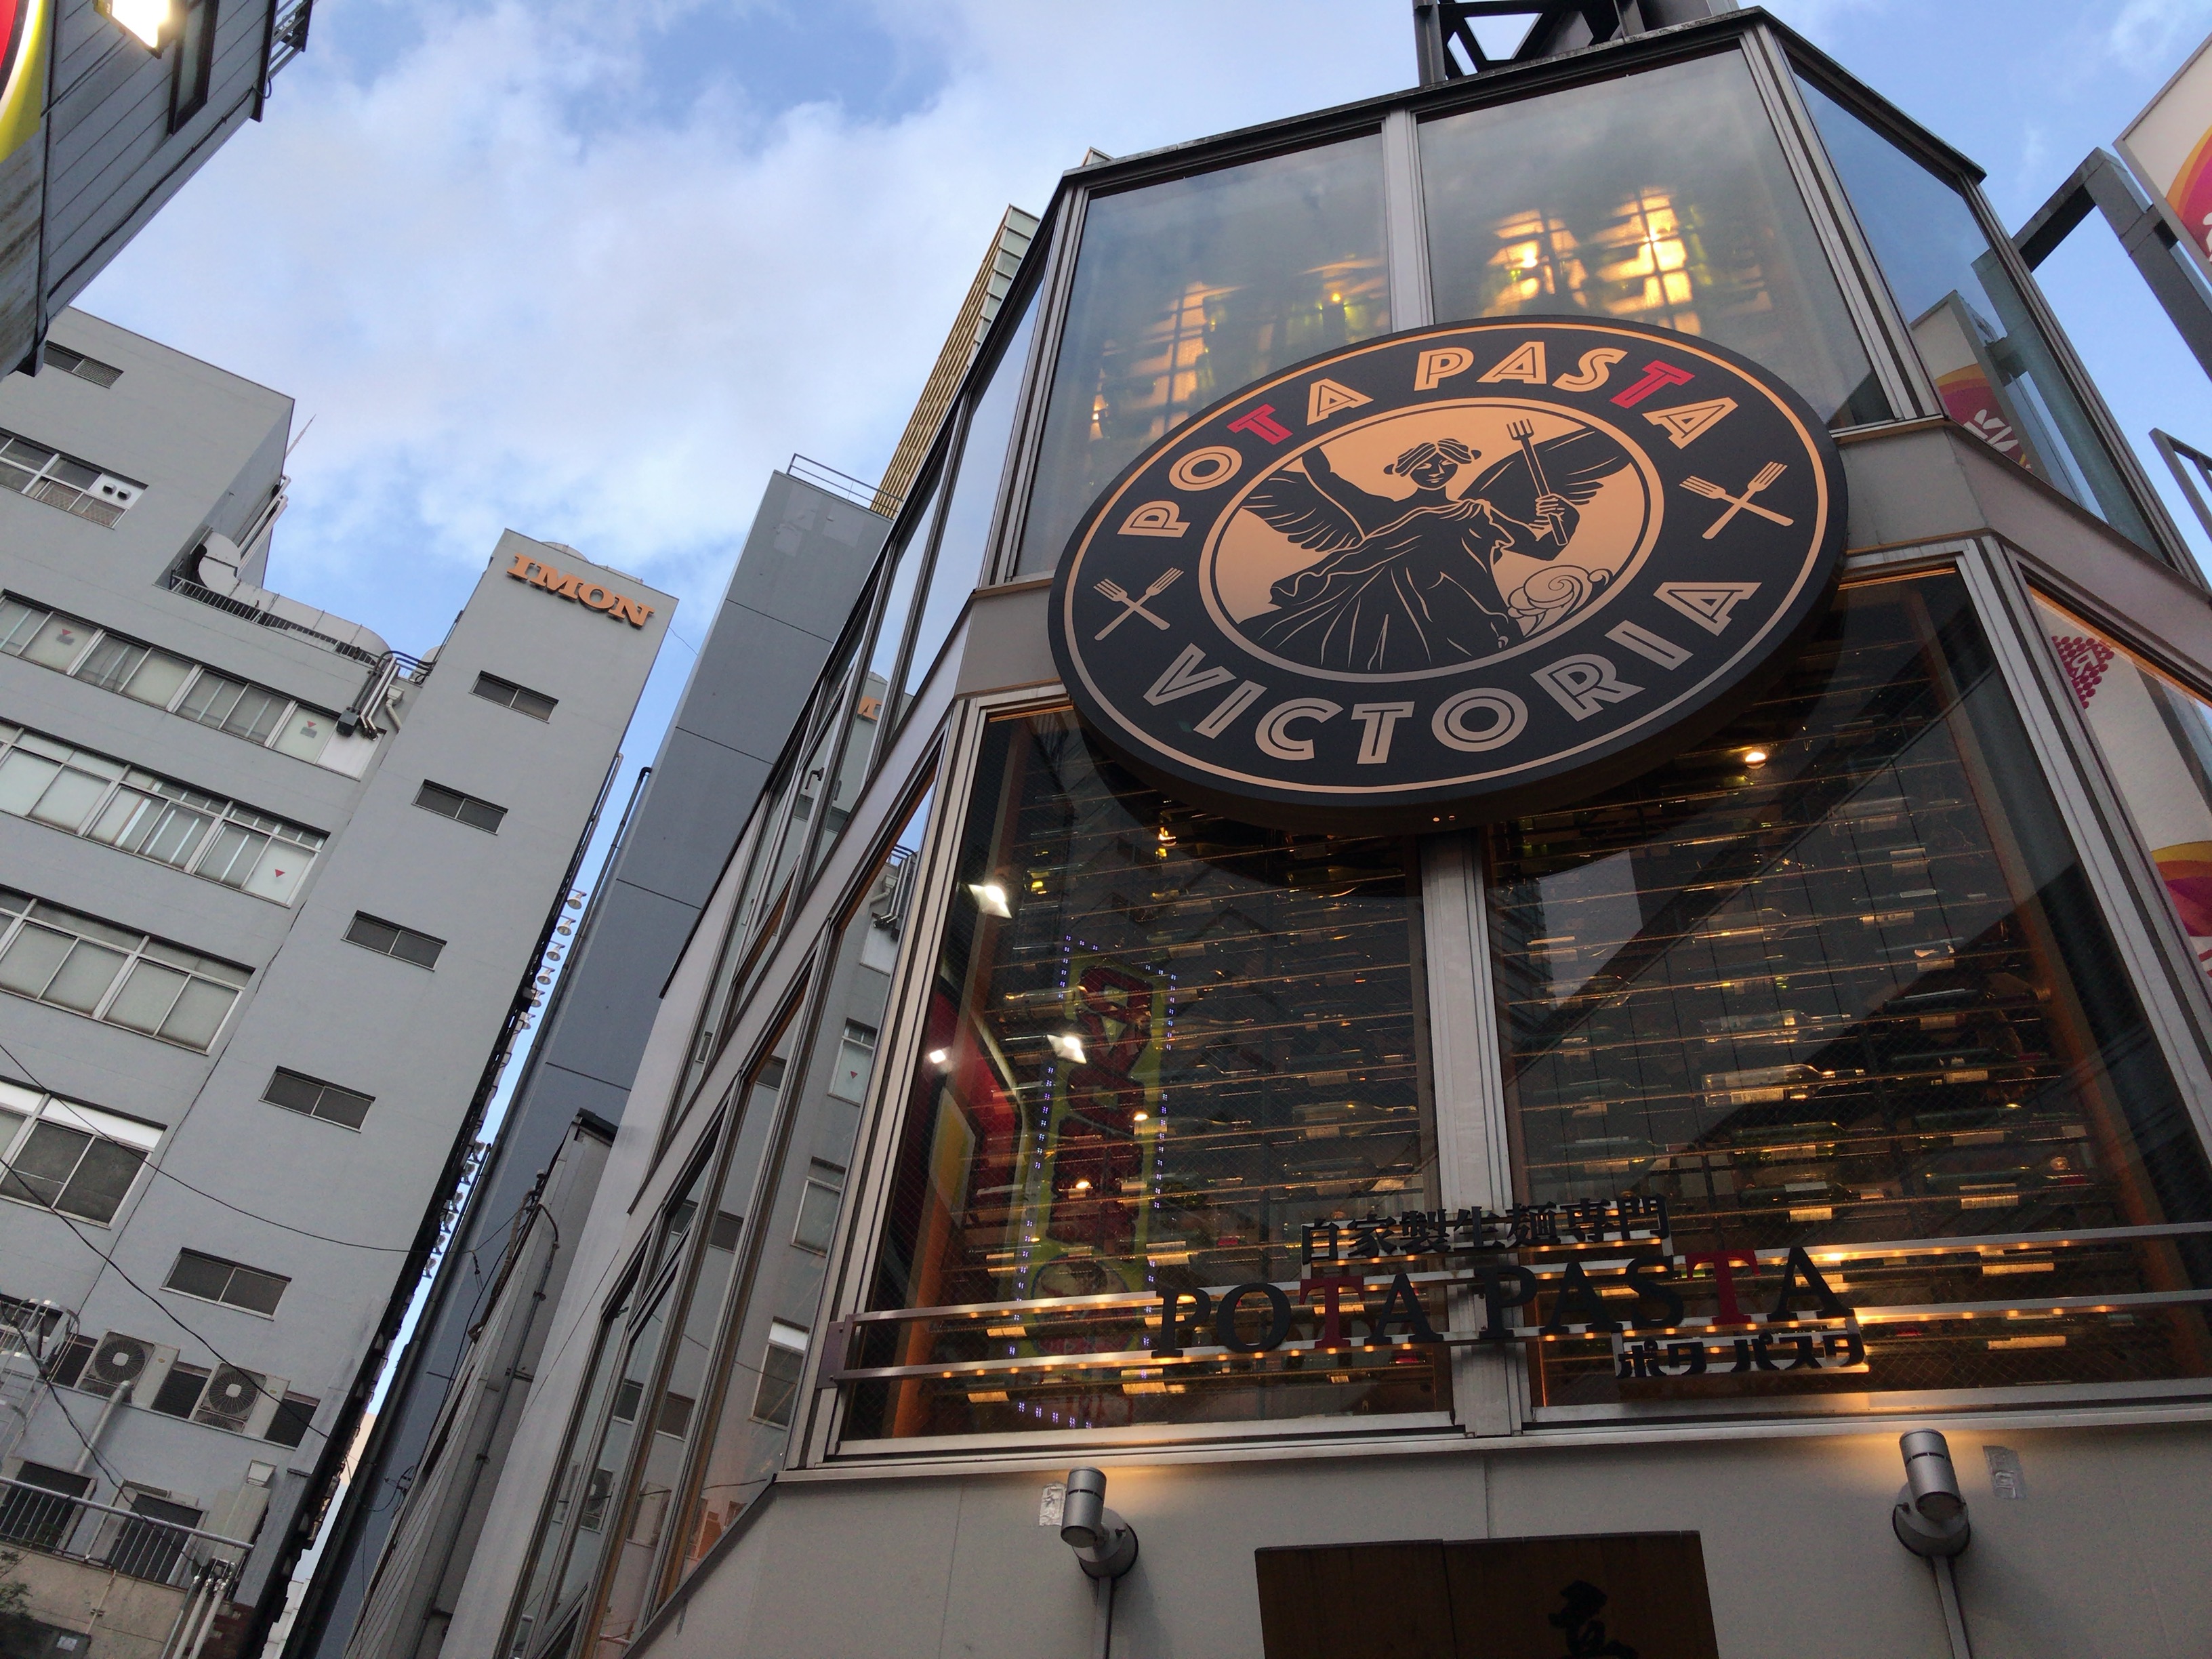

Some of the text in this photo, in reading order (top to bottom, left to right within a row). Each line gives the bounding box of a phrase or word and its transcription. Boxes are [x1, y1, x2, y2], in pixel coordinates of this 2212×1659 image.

[1118, 341, 1740, 539] POTA PASTA
[507, 552, 655, 628] IMON
[1143, 581, 1762, 766] VICTORIA
[1150, 1246, 1856, 1359] POTA PASTA
